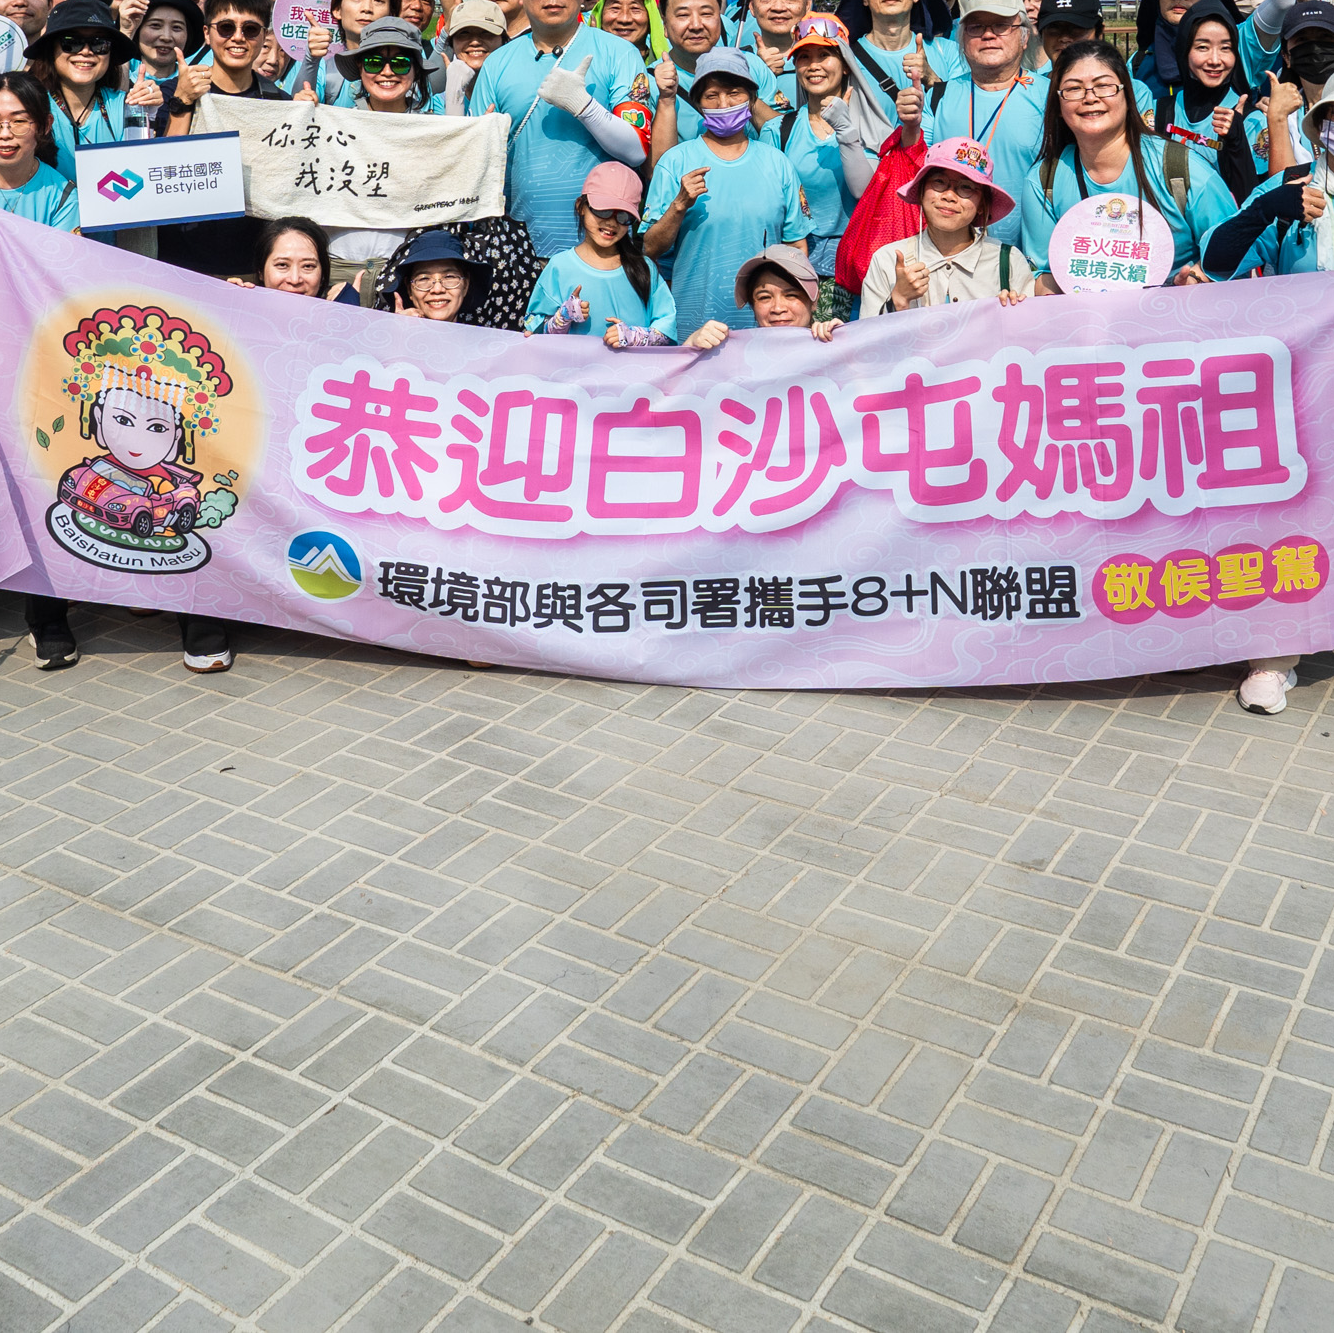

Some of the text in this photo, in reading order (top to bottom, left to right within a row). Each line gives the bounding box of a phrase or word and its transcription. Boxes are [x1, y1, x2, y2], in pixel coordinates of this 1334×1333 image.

[262, 118, 356, 150] 你安心
[148, 161, 224, 181] 百事益國際
[155, 177, 218, 195] Bestyield
[295, 159, 390, 198] 我沒塑
[1073, 236, 1150, 260] 香火延續
[1069, 259, 1147, 283] 環境永續
[304, 352, 1292, 524] 恭迎白沙屯媽祖
[55, 514, 201, 567] Baishatun Matsu
[1103, 542, 1322, 613] 敬候聖駕
[378, 560, 1081, 634] 環境部與各司署攜手8+N聯盟
